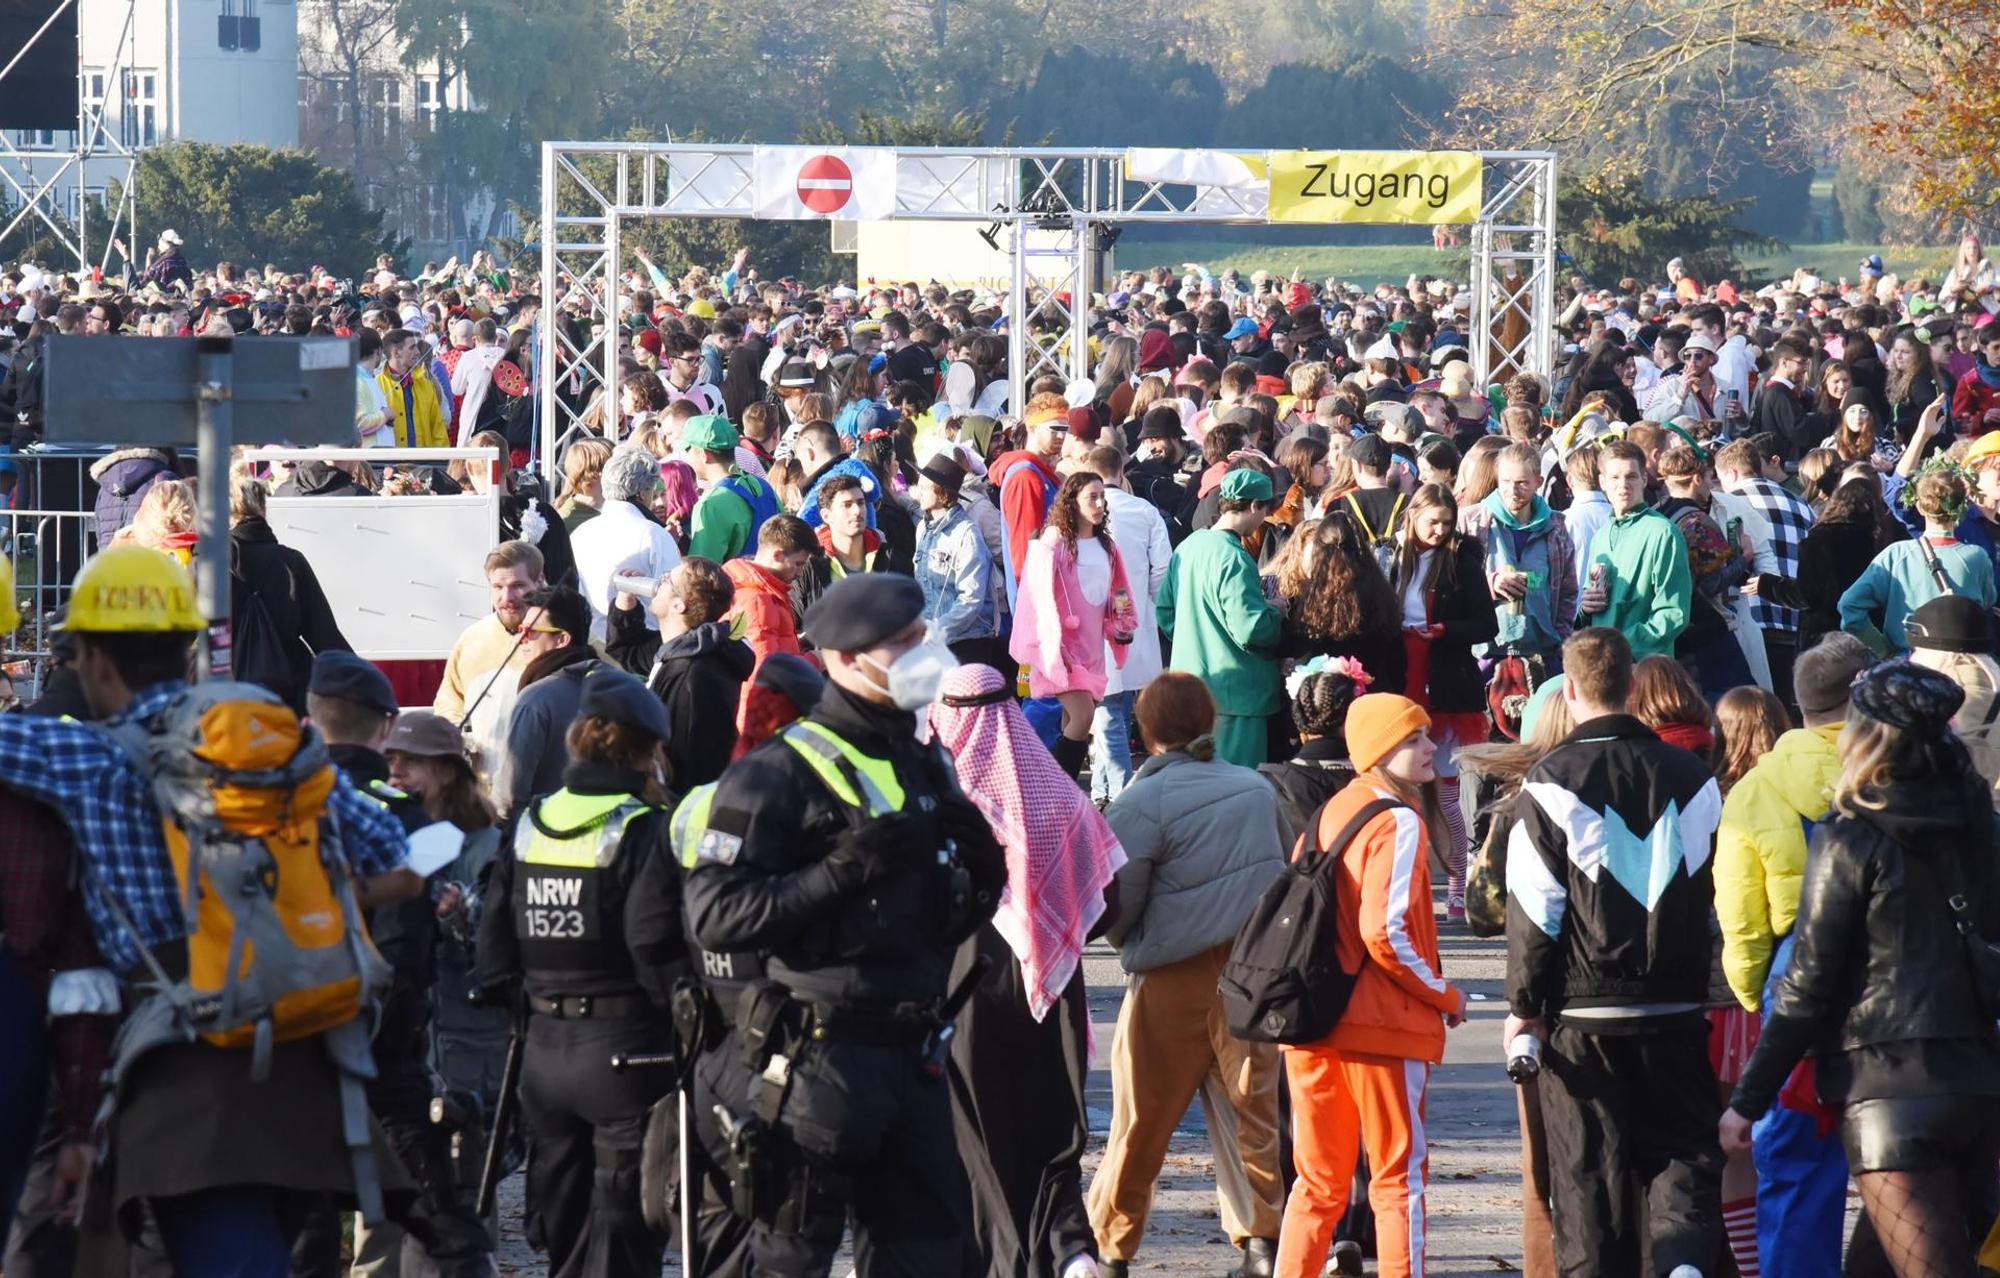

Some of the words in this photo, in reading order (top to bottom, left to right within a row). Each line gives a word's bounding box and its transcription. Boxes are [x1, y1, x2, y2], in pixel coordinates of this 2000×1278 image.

[1300, 163, 1449, 208] Zugang
[526, 877, 583, 906] NRW
[525, 909, 585, 937] 1523
[702, 949, 734, 978] RH
